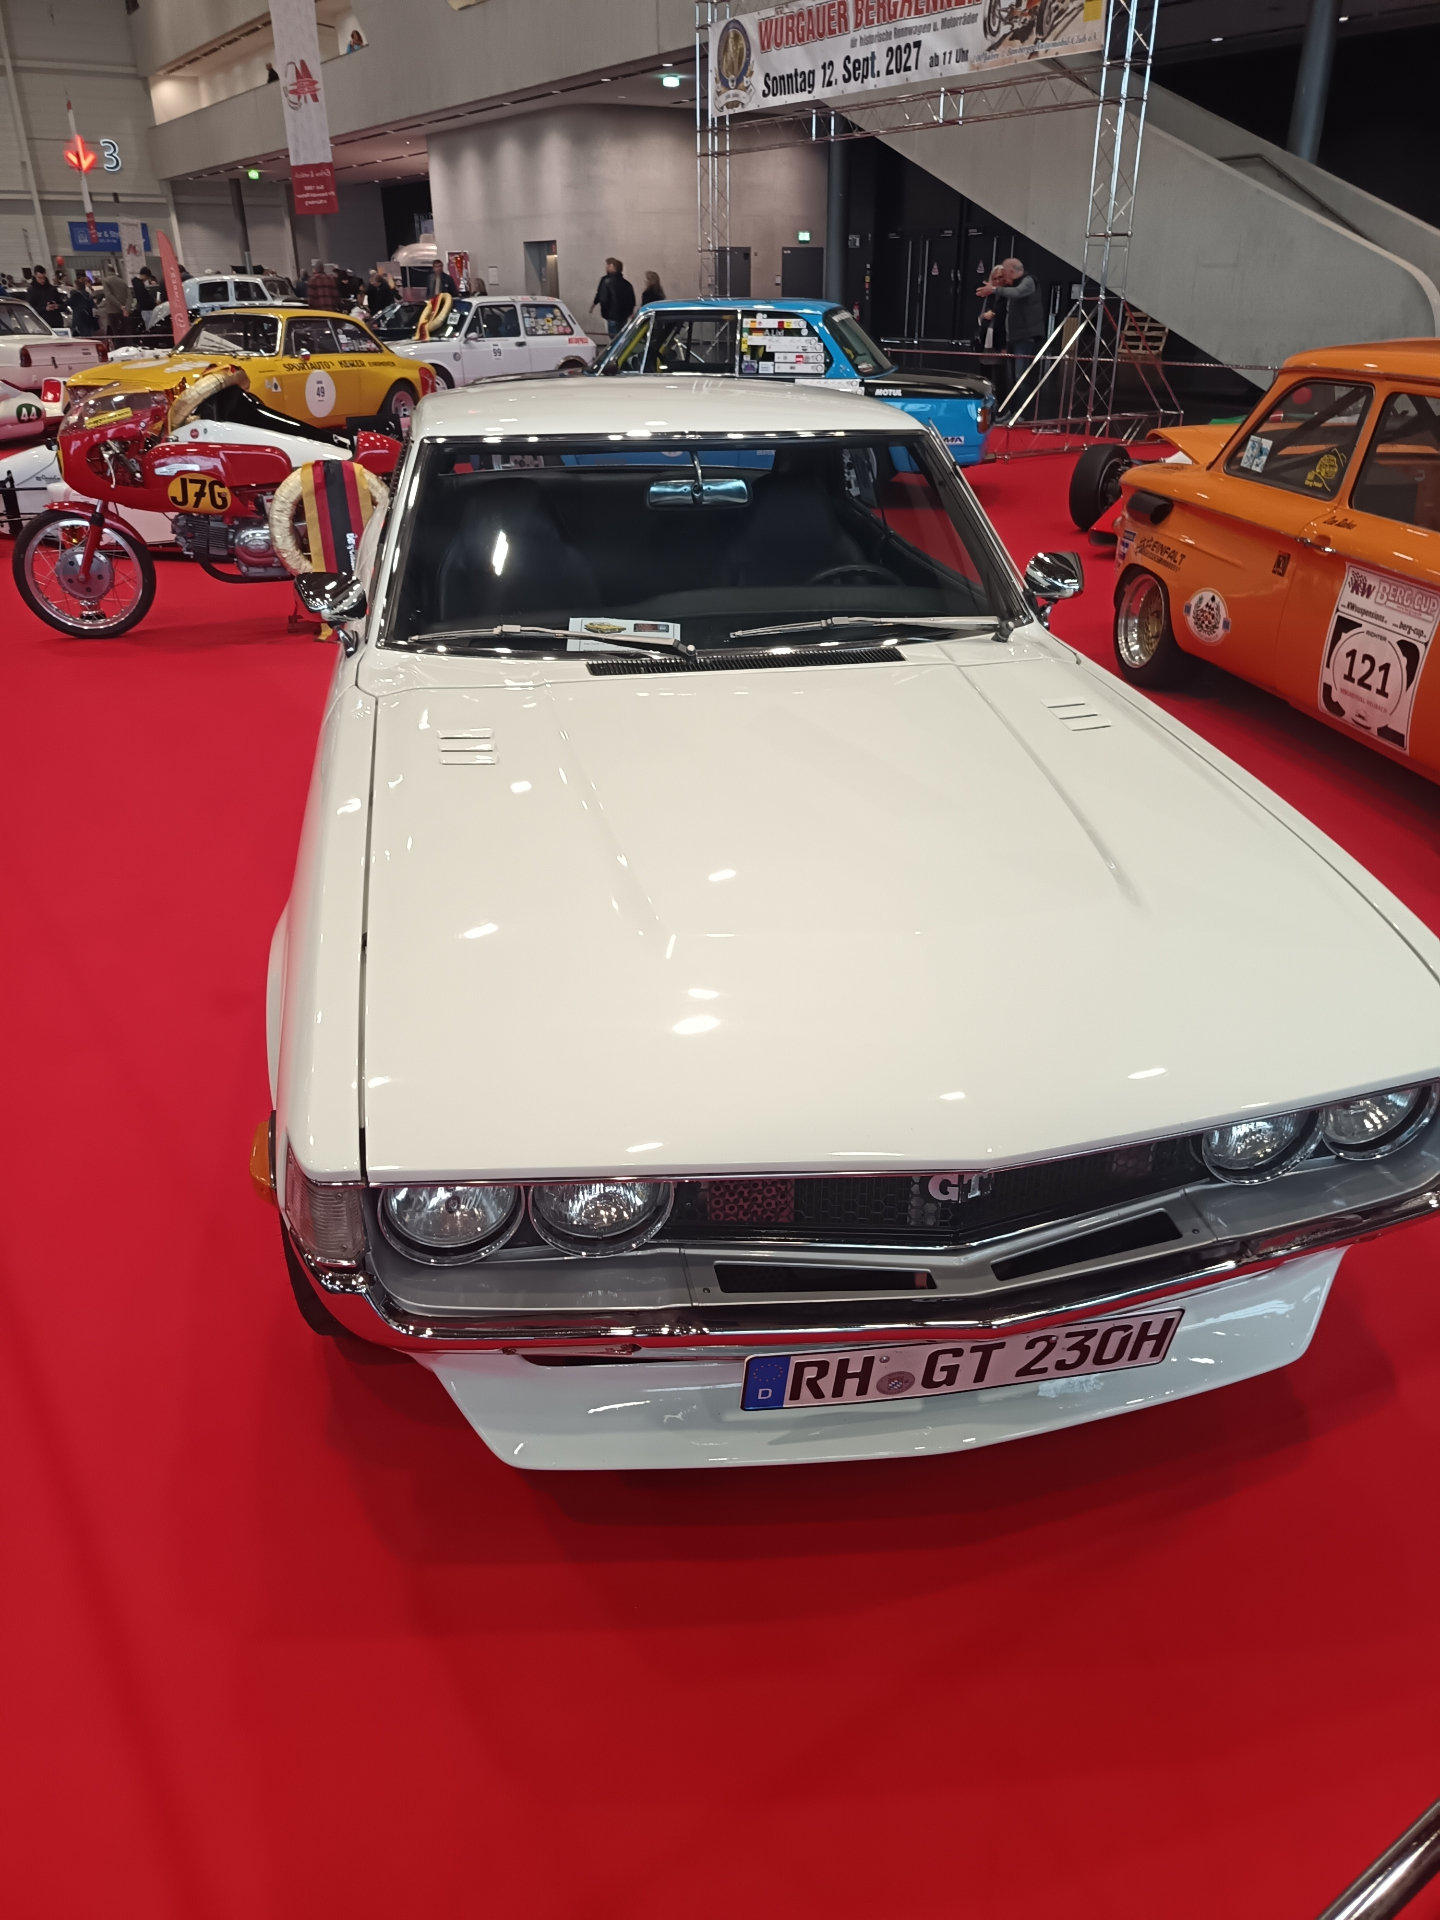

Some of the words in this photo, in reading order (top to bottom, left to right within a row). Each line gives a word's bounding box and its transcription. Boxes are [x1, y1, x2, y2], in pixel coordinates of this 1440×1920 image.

[758, 0, 849, 51] WÜRGAUER
[853, 0, 981, 30] BERGRE
[893, 22, 932, 40] Rennwagen
[941, 13, 979, 30] Motorräder
[762, 67, 815, 98] Sonntag
[821, 61, 838, 89] 12.
[842, 51, 880, 84] Sept.
[885, 40, 922, 76] 2027
[929, 52, 939, 68] ab
[943, 50, 953, 66] 11
[955, 48, 969, 64] Uhr
[100, 138, 122, 172] 3
[316, 386, 325, 397] 49
[874, 388, 903, 397] MOTUL
[20, 406, 38, 421] 44
[170, 477, 229, 510] J7G
[1151, 540, 1187, 567] EINFALT
[1350, 578, 1376, 600] KW
[1343, 648, 1391, 699] 121
[928, 1174, 981, 1202] GT
[788, 1356, 876, 1402] RH
[920, 1341, 1006, 1389] GT
[1015, 1316, 1177, 1377] 230H
[757, 1387, 773, 1401] D
